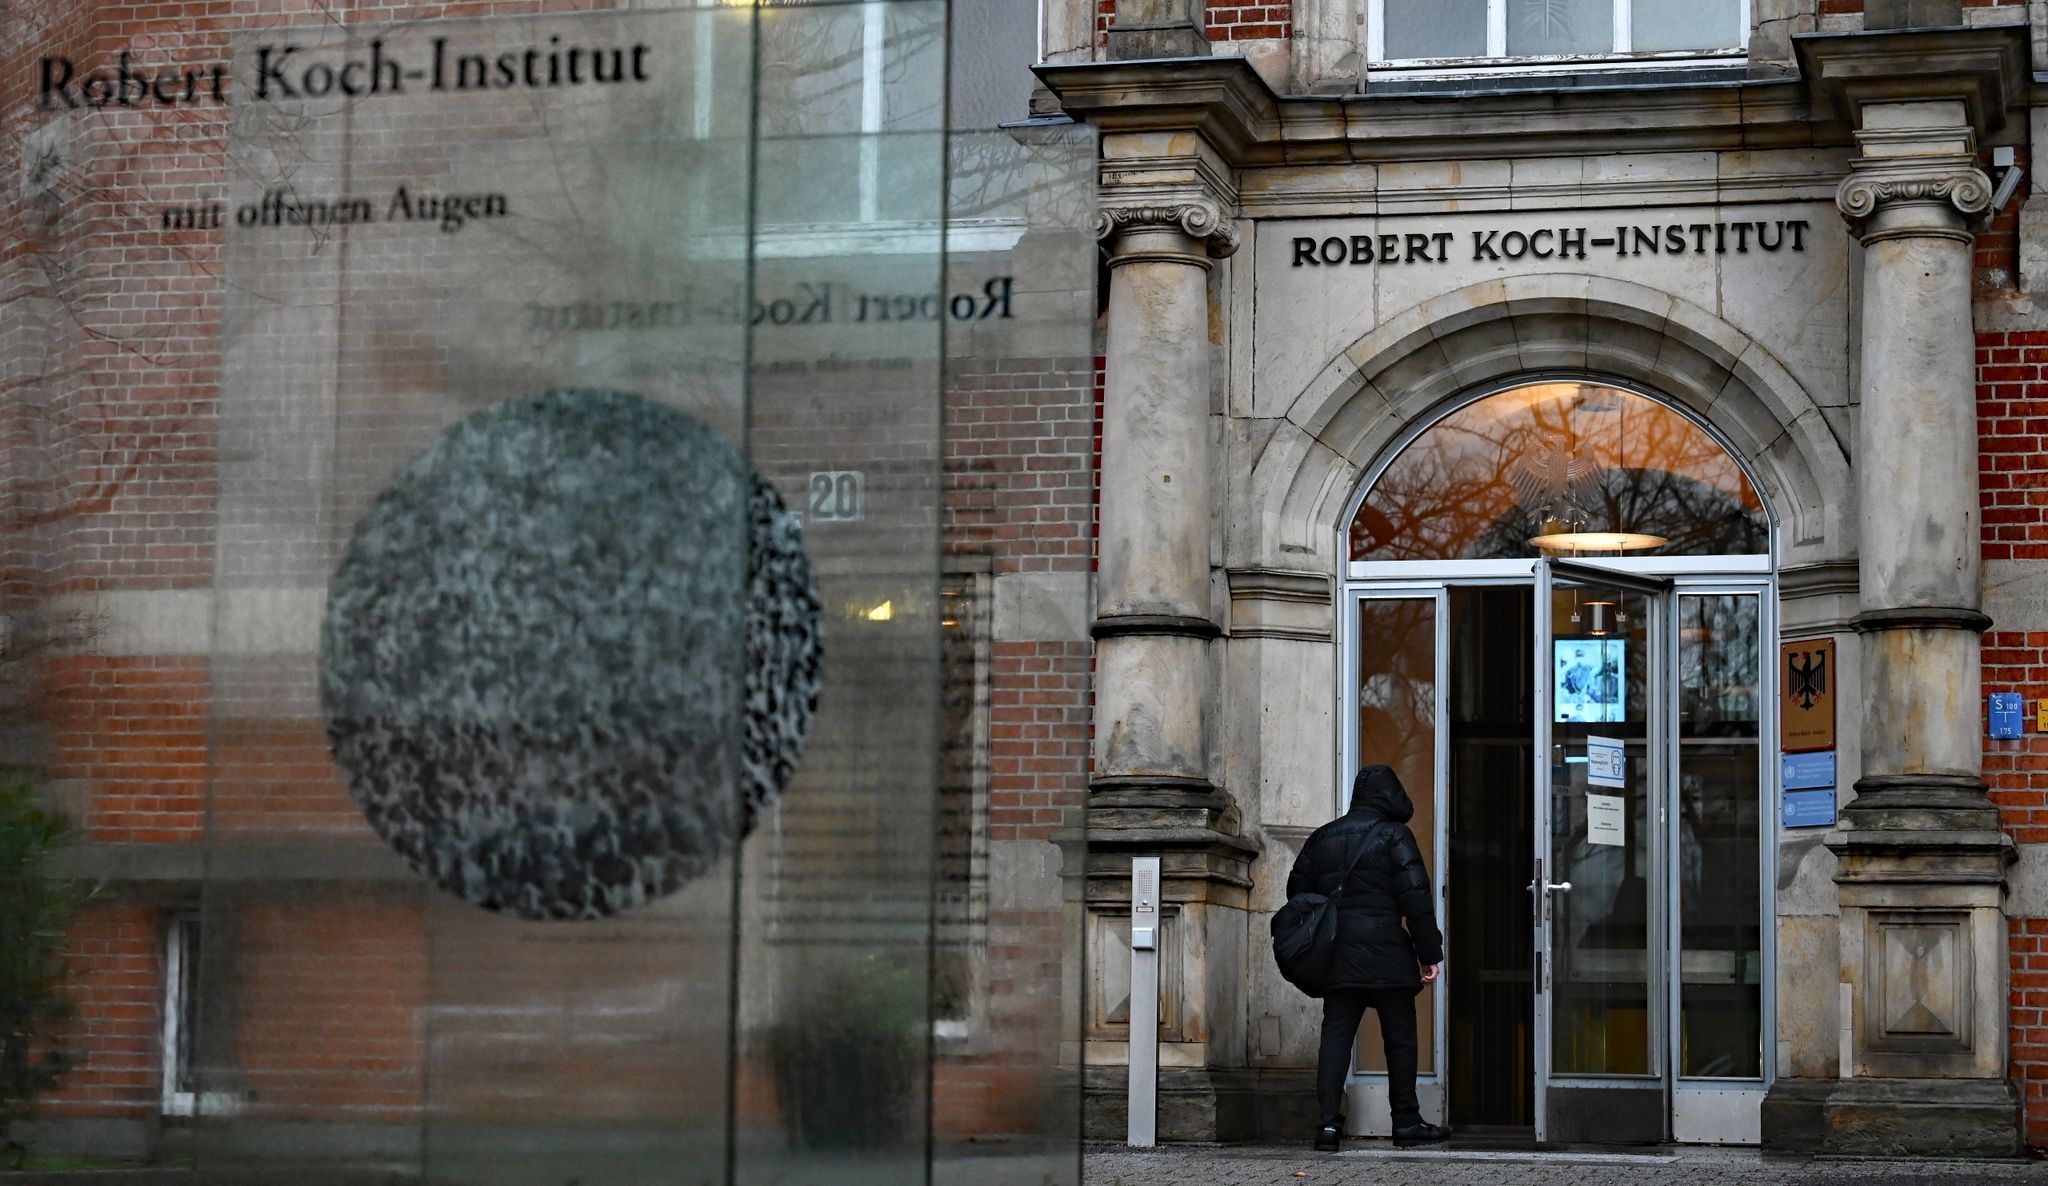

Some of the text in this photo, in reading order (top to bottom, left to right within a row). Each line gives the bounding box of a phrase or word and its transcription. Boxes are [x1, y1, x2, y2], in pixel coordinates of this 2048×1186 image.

[38, 35, 651, 110] Robert Koch-Institut
[162, 186, 510, 235] mit offenen Augen
[1292, 220, 1810, 268] ROBERT KOCH-INSTITUT
[811, 473, 858, 520] 20
[1995, 699, 2003, 710] S
